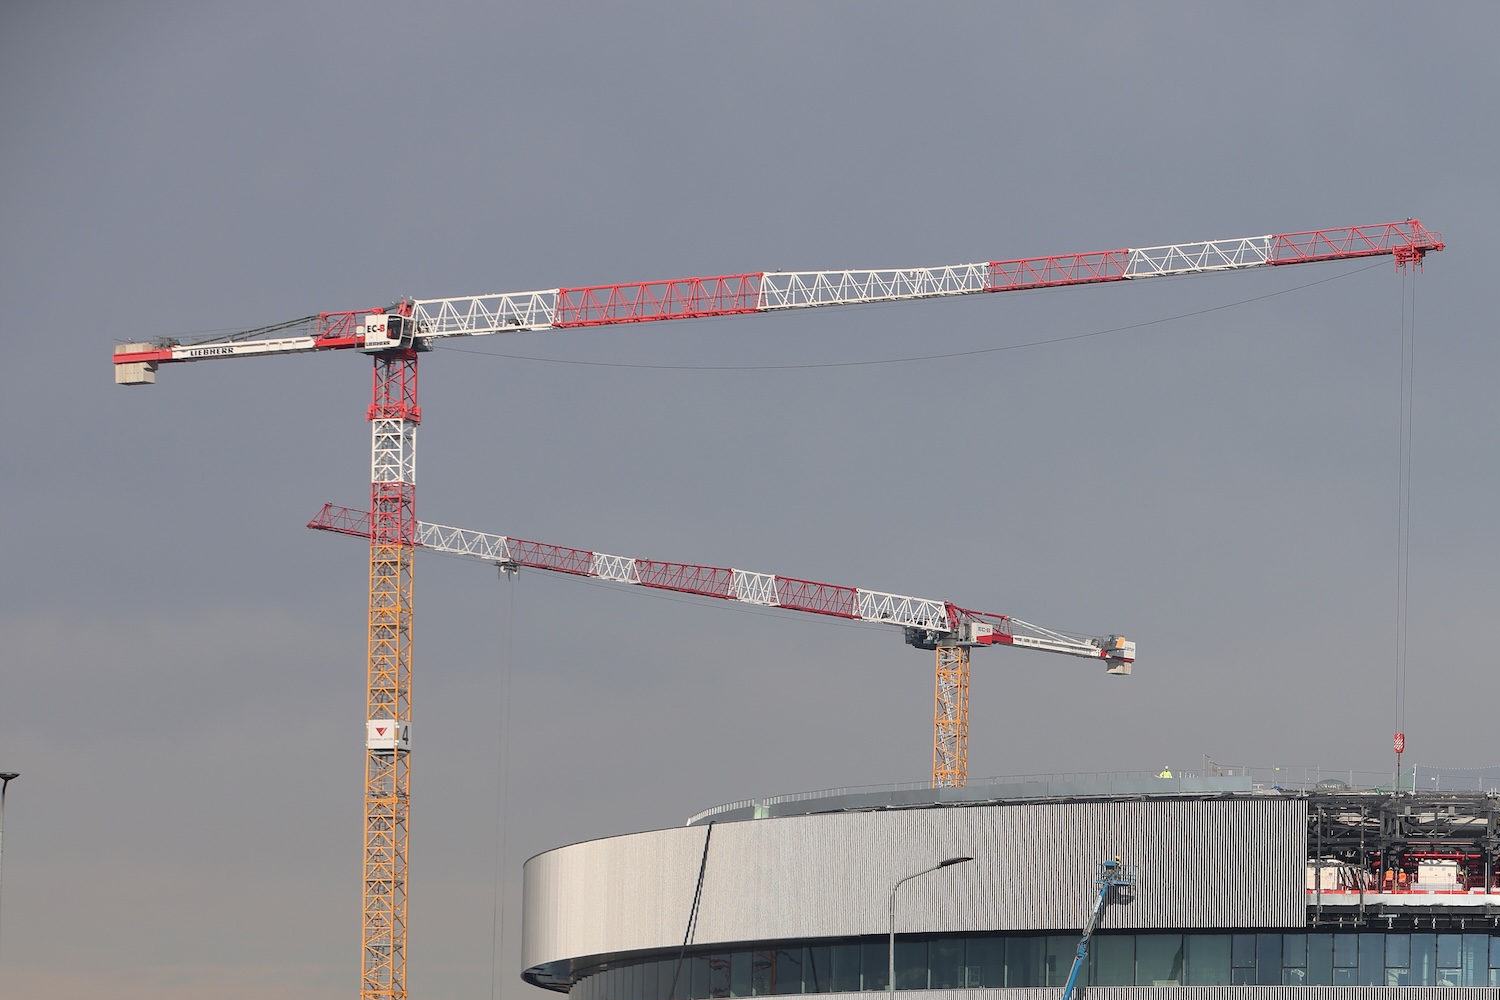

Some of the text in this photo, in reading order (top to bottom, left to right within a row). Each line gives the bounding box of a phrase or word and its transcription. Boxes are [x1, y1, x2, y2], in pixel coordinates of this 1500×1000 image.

[366, 324, 385, 333] EC-B
[190, 348, 234, 356] LIEBHERR
[402, 726, 409, 745] 4
